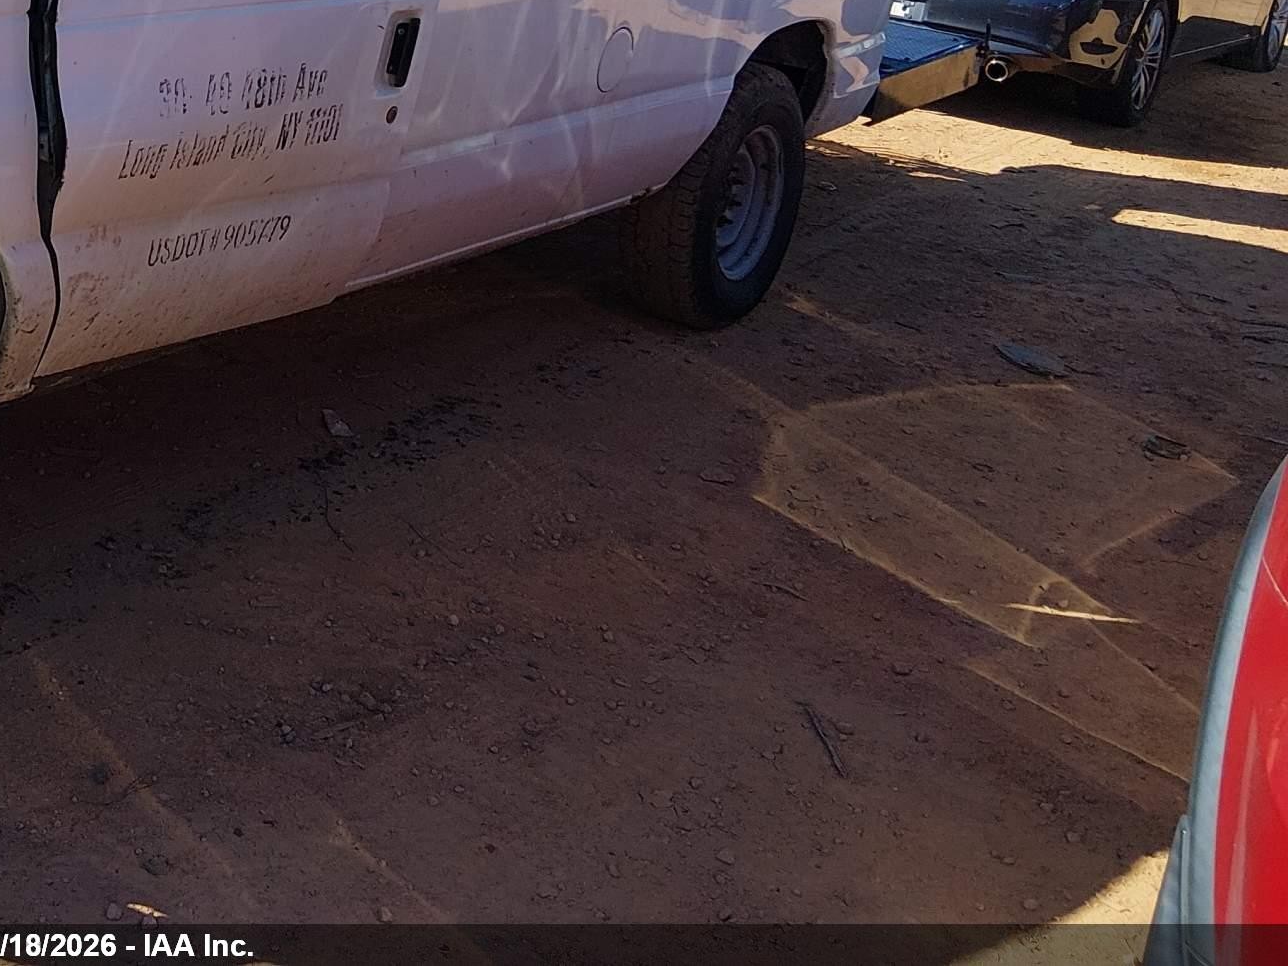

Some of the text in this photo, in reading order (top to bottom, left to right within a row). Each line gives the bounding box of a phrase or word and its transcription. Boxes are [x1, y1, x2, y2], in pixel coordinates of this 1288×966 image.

[292, 63, 328, 103] Ave
[118, 139, 168, 179] Long
[169, 124, 229, 170] Island
[275, 110, 304, 151] NY
